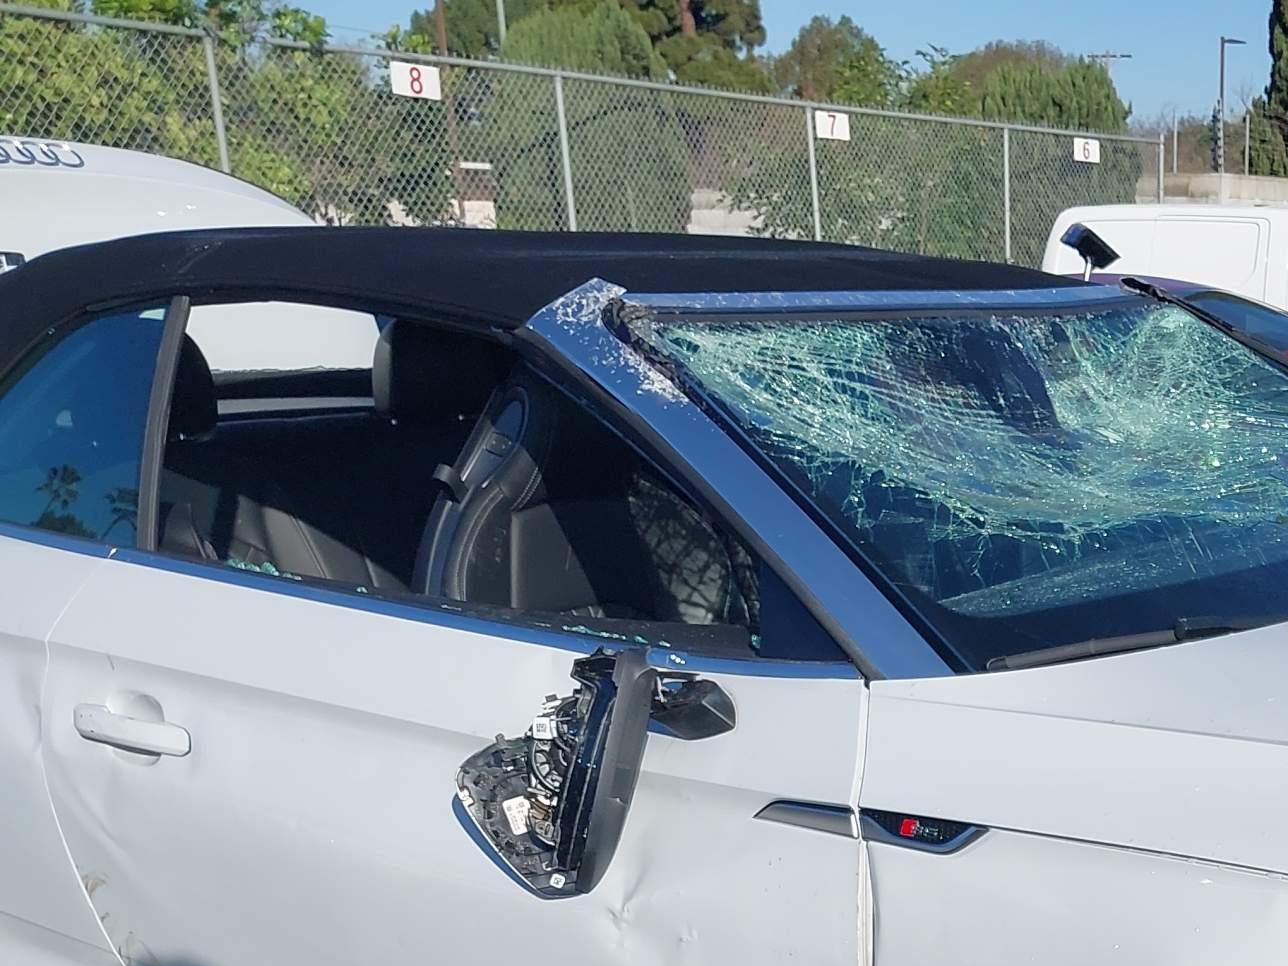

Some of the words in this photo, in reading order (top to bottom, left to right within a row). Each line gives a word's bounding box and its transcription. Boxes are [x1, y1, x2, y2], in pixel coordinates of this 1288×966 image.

[409, 66, 423, 94] 8
[827, 114, 836, 137] 7
[1083, 141, 1090, 160] 6
